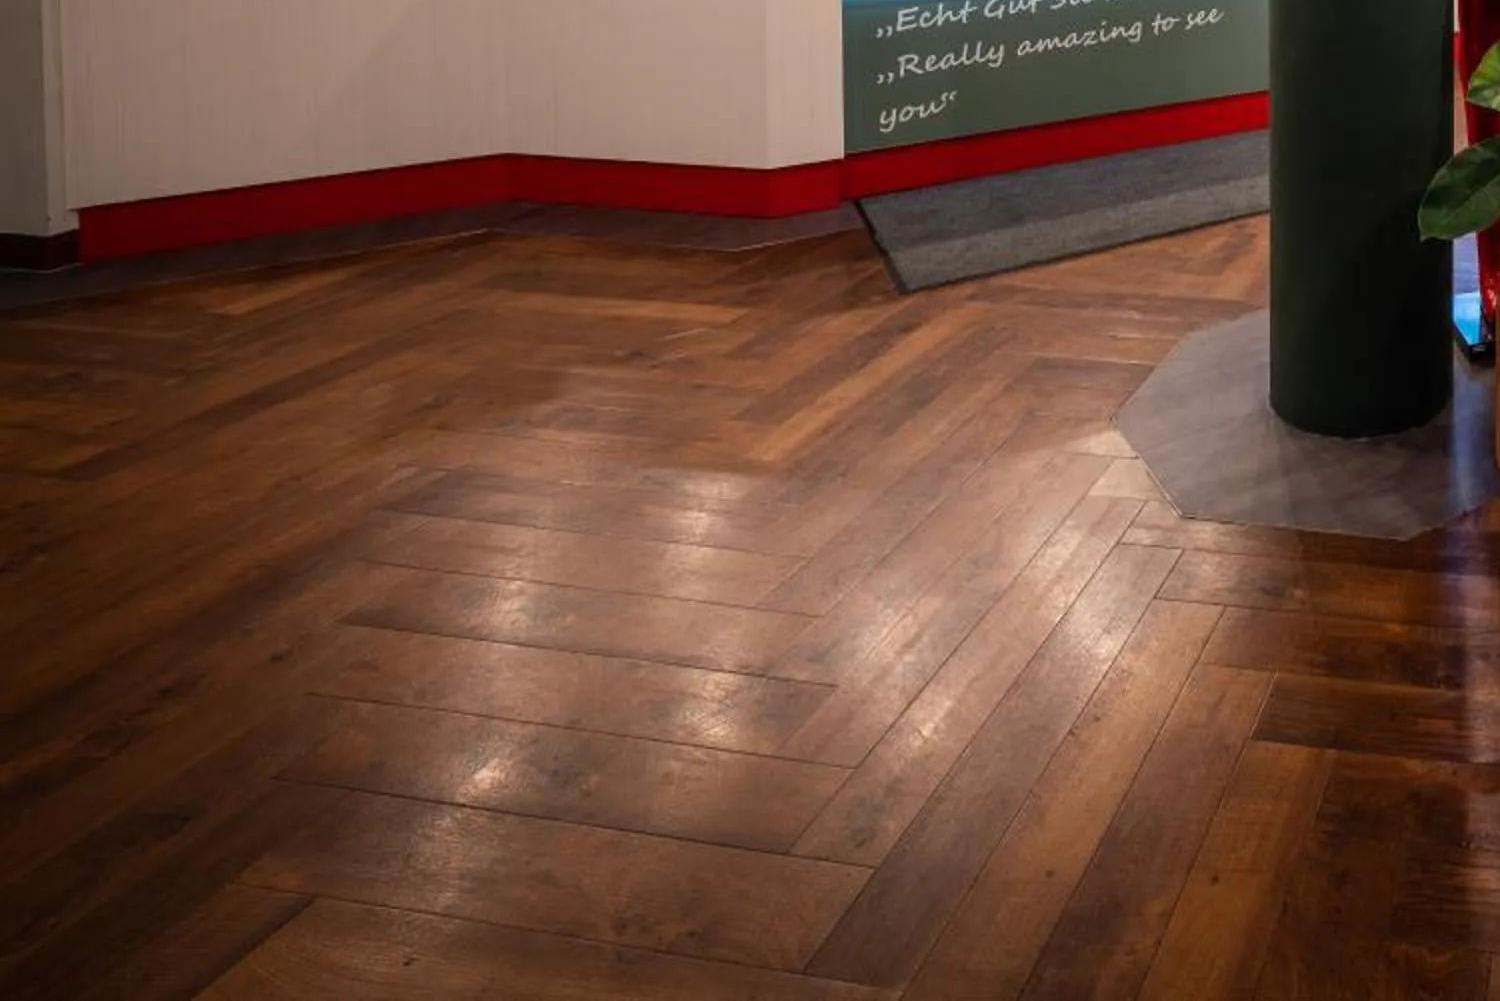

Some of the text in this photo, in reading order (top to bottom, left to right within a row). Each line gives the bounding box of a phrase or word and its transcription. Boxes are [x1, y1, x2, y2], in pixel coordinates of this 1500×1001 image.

[1017, 20, 1144, 57] amazing
[1151, 12, 1180, 36] to
[1185, 8, 1225, 30] see
